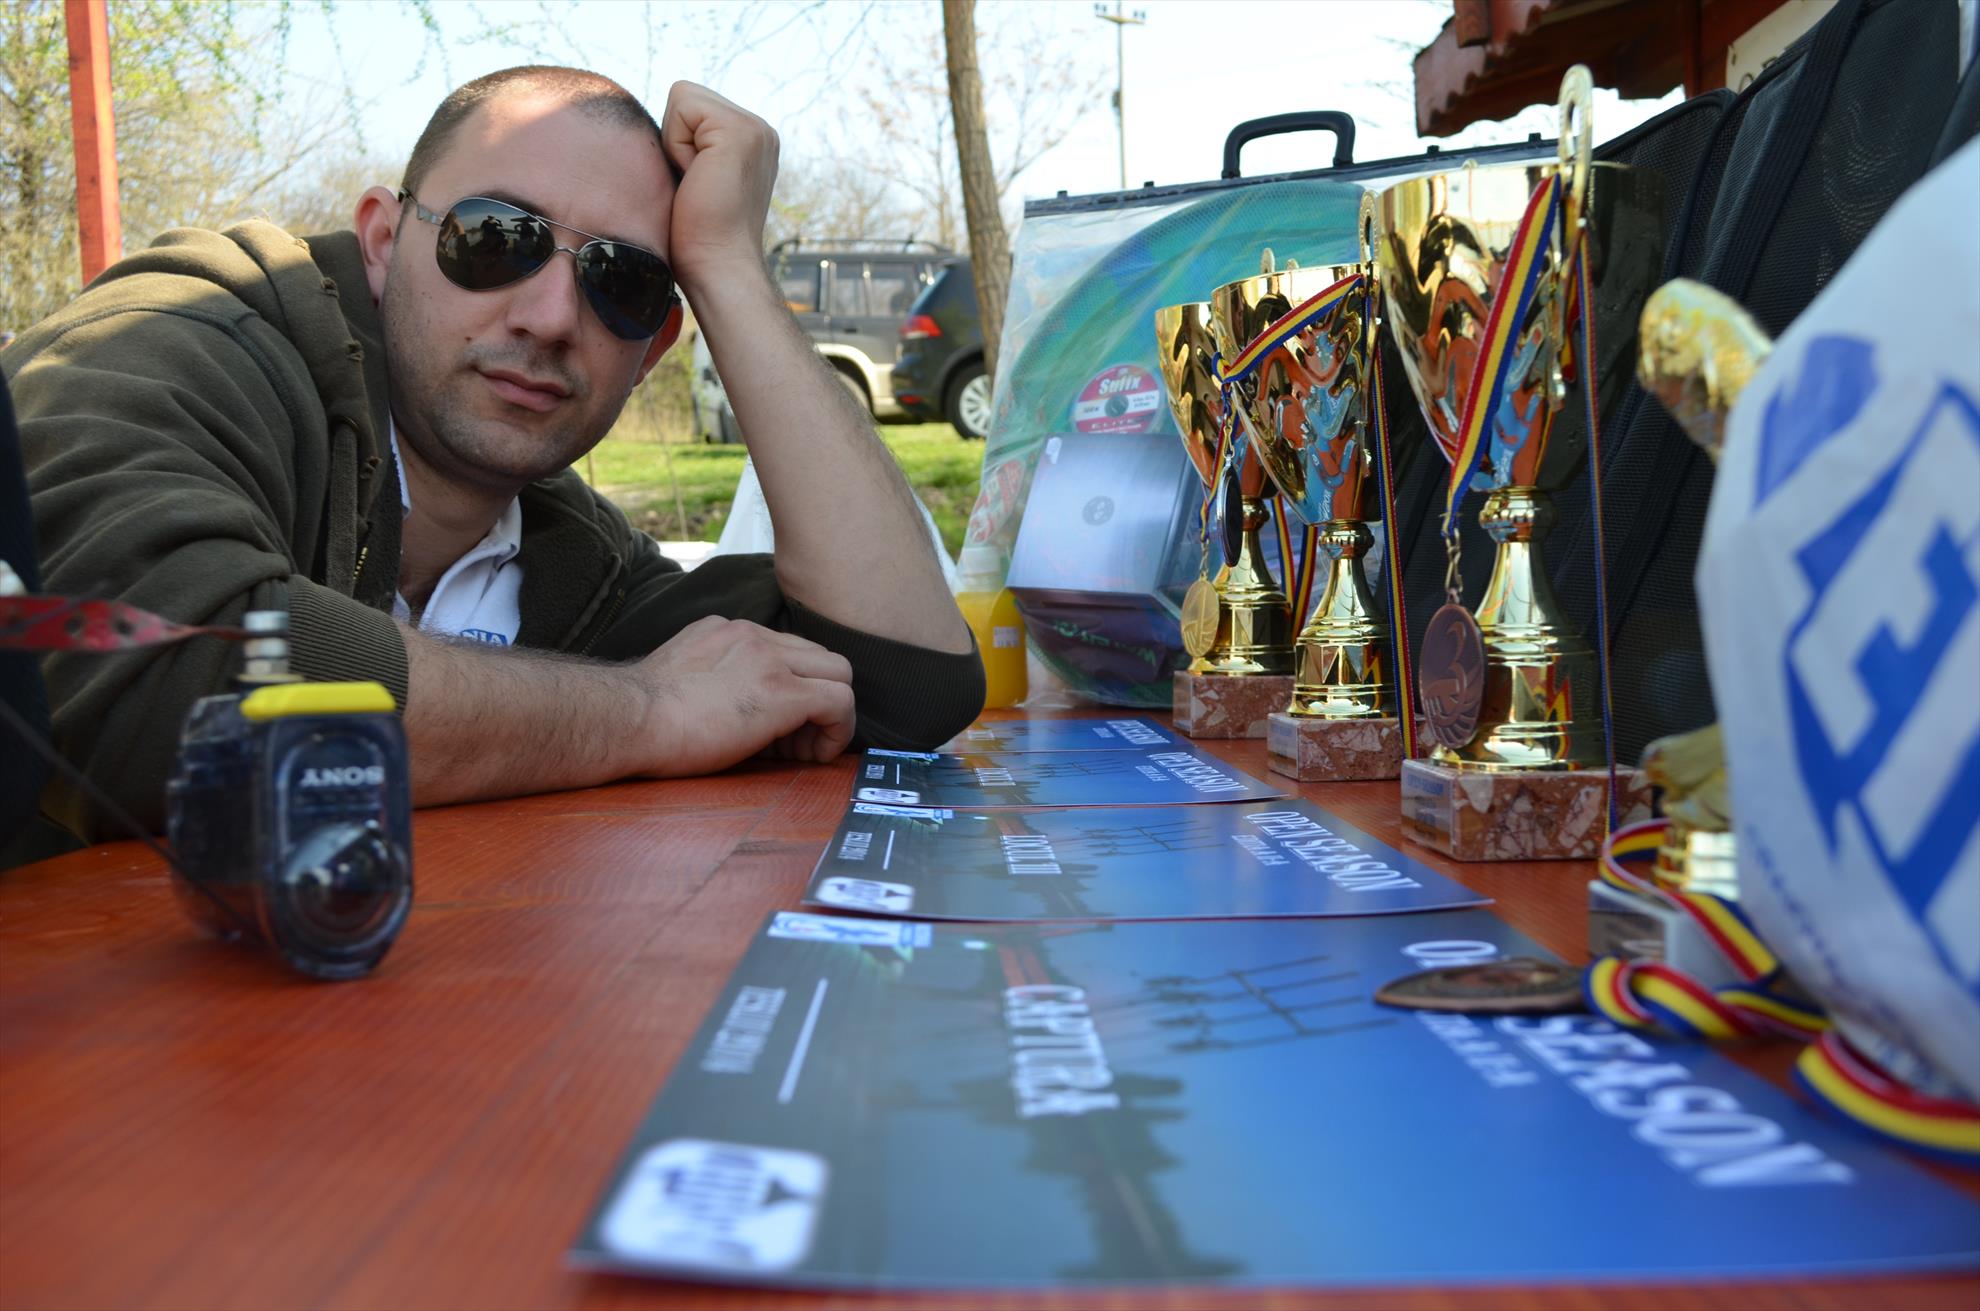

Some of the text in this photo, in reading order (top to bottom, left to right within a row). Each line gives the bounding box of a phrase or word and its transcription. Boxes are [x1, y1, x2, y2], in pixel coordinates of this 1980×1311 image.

[300, 765, 385, 787] SONY
[1243, 811, 1333, 839] OPEN
[1280, 837, 1423, 892] SEASON
[1003, 984, 1120, 1118] CAPTURA
[1494, 1014, 1855, 1187] SEASON
